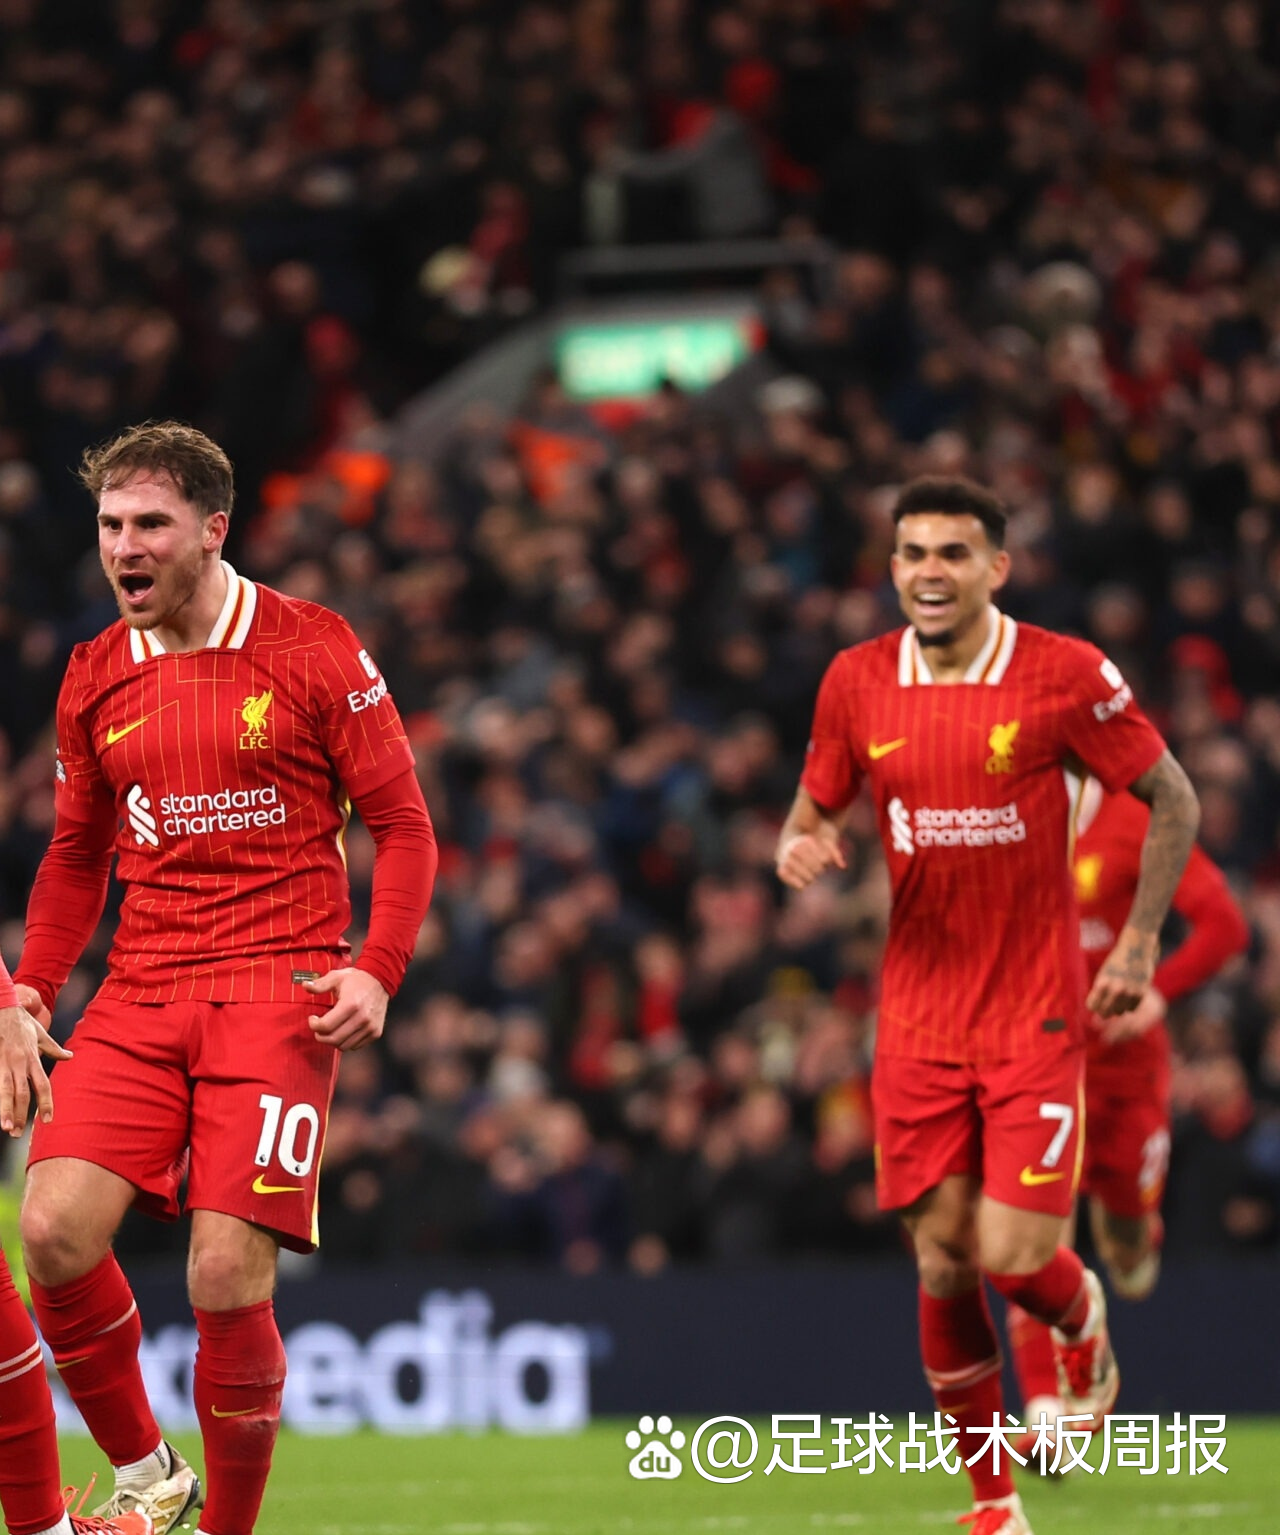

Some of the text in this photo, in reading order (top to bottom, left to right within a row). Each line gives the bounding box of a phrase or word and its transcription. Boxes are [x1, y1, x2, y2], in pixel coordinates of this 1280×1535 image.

[160, 784, 277, 815] standard
[914, 801, 1018, 829] standard
[163, 802, 286, 836] chartered
[914, 819, 1026, 847] chartered
[254, 1093, 320, 1177] 10
[1039, 1102, 1074, 1168] 7
[141, 1288, 590, 1436] edia
